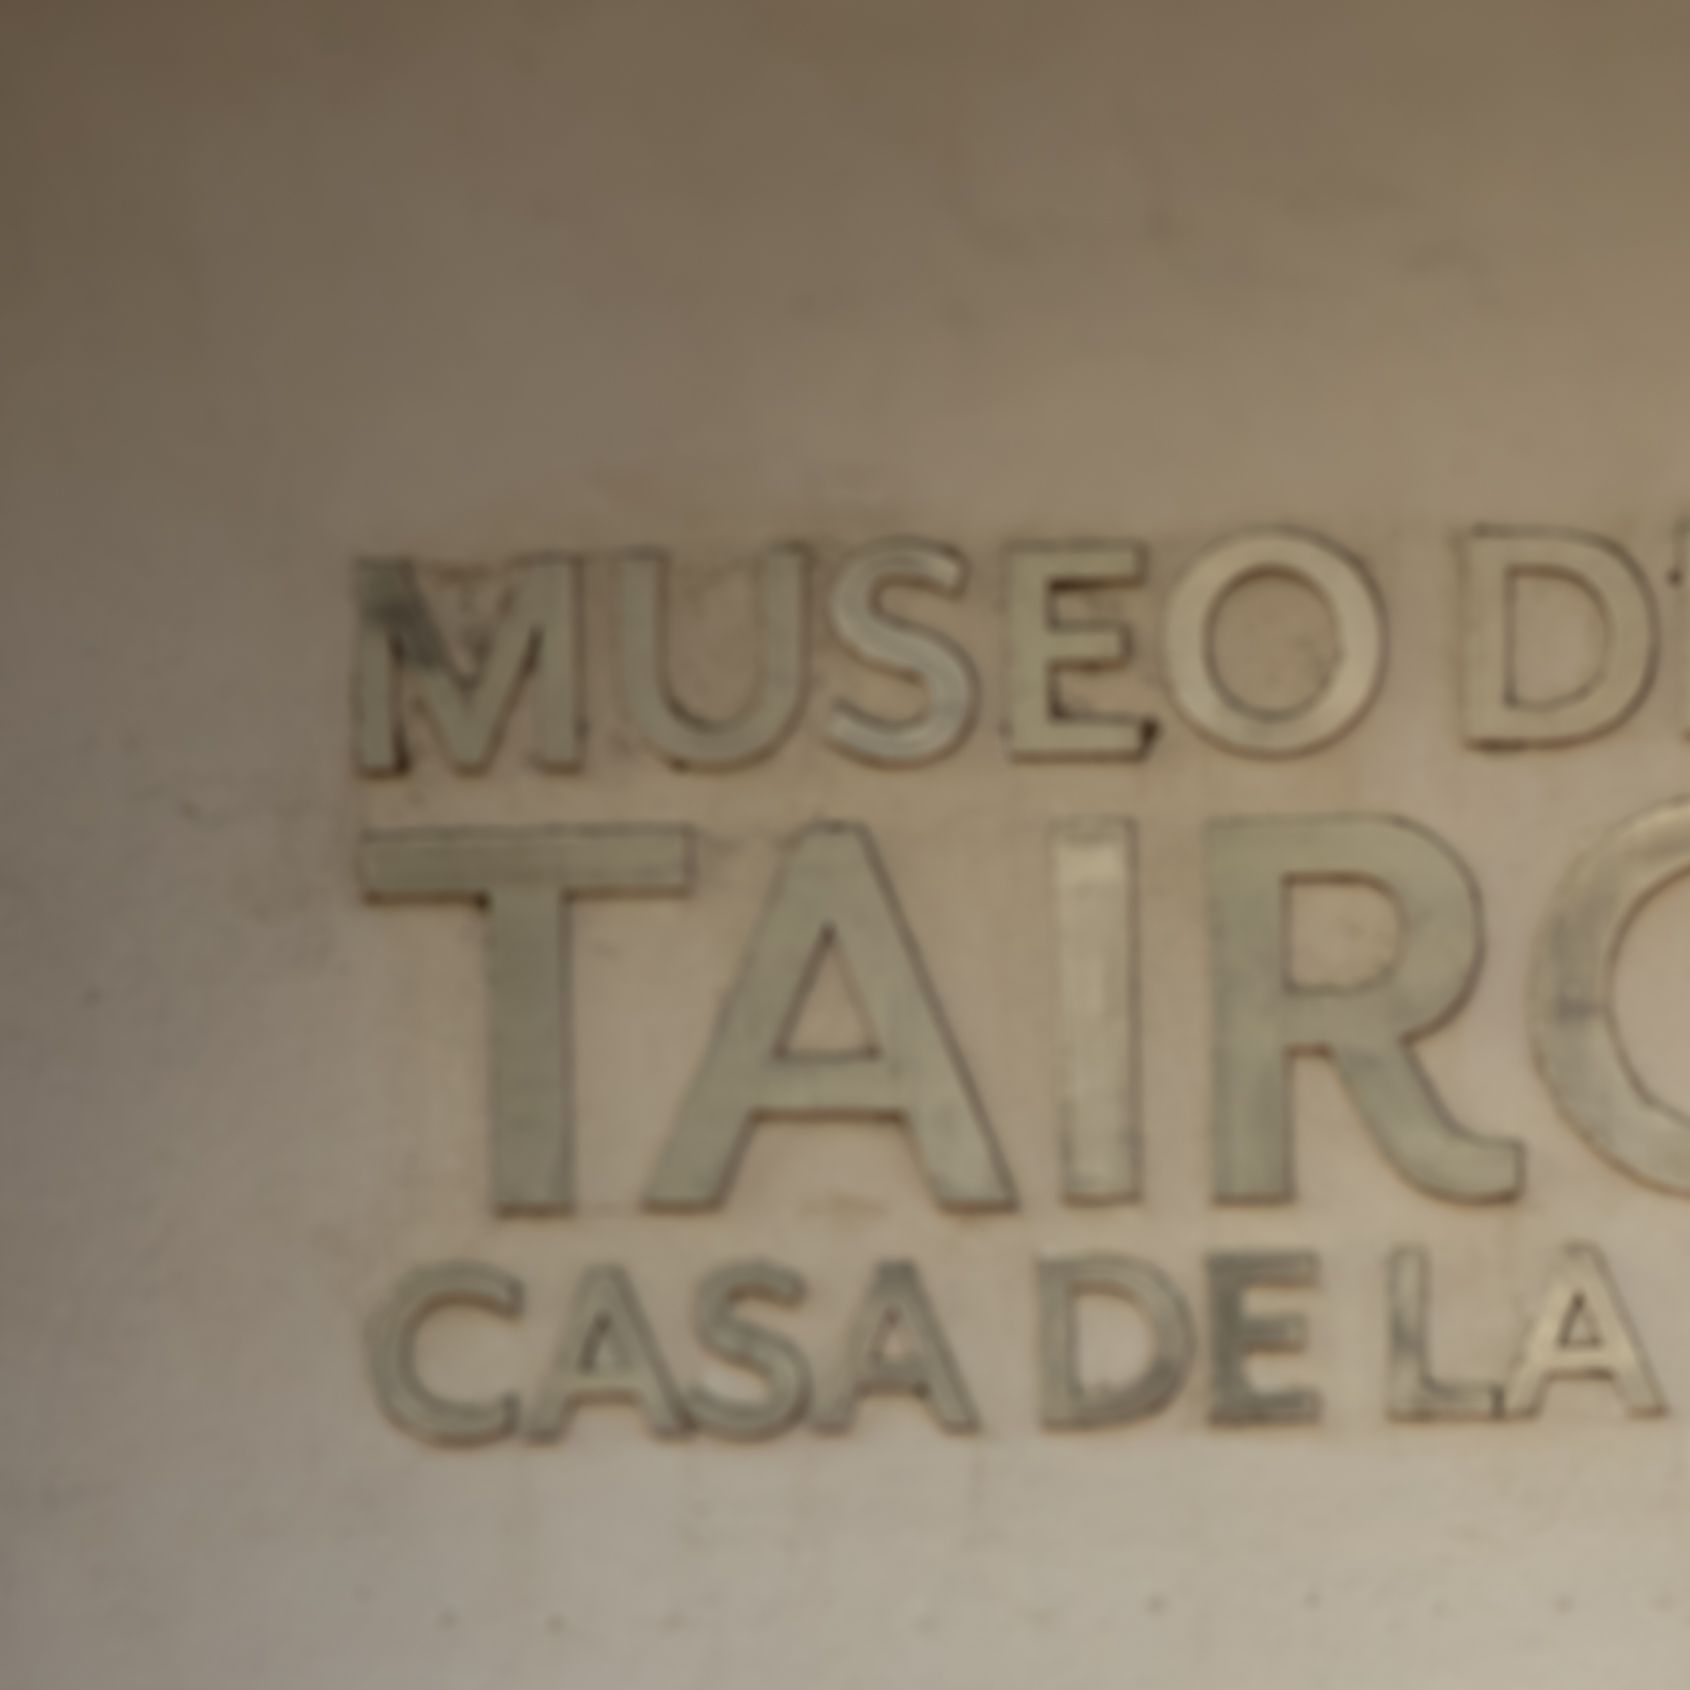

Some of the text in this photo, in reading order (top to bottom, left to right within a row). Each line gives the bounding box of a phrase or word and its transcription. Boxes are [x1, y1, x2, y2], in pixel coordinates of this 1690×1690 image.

[349, 524, 1388, 778] MUSEO
[364, 1257, 984, 1446] CASA
[1032, 1245, 1325, 1432] DE
[1384, 1237, 1667, 1427] LA
